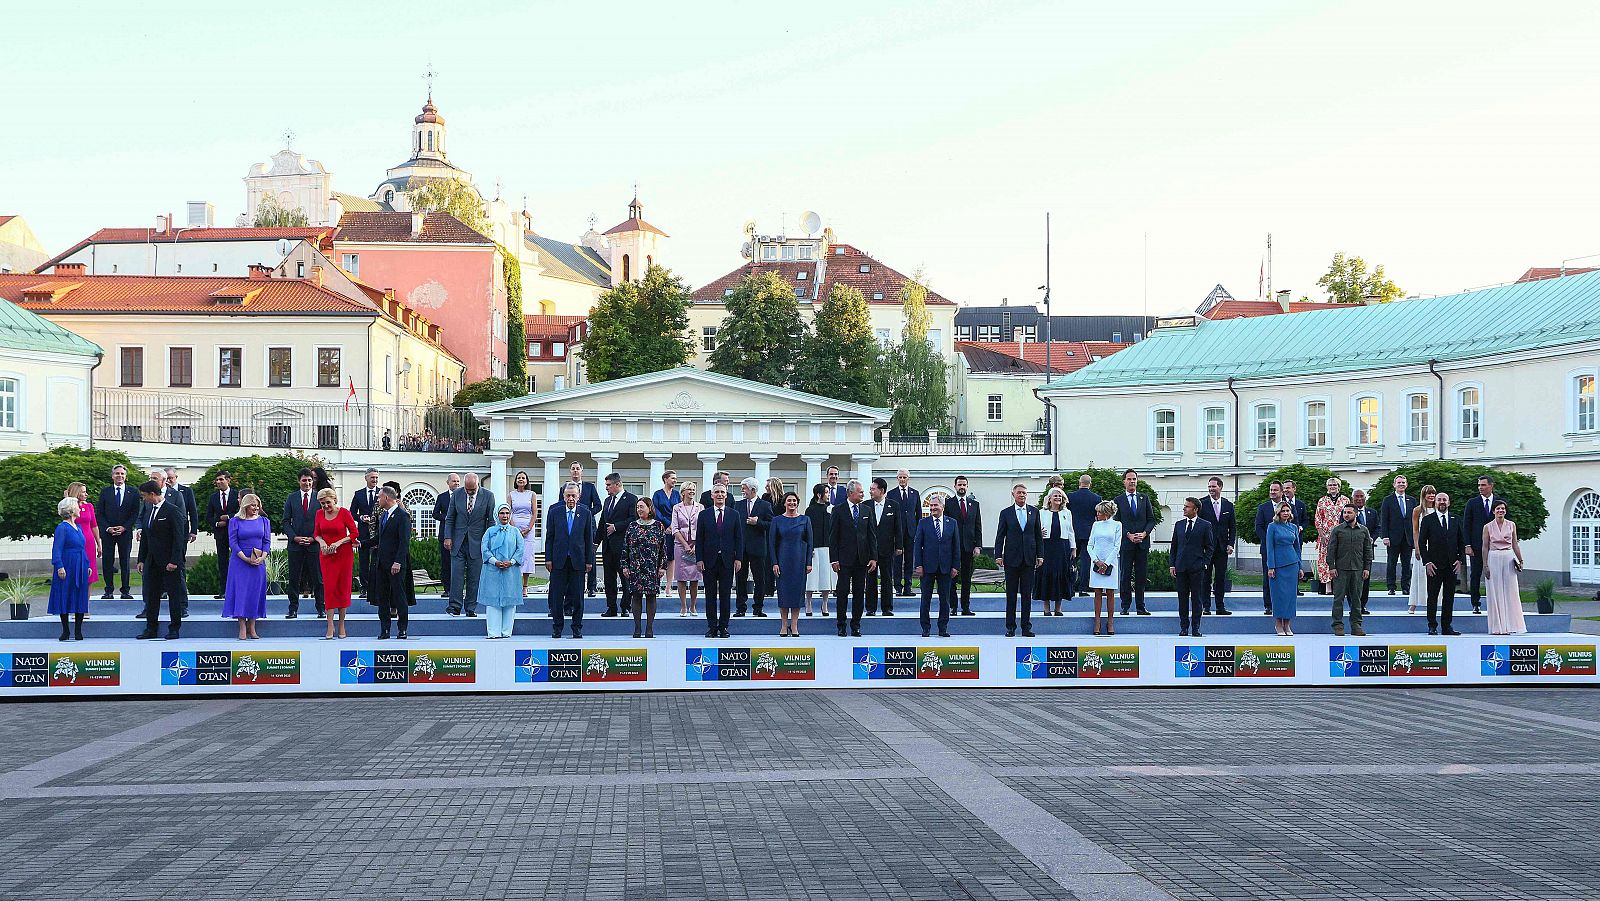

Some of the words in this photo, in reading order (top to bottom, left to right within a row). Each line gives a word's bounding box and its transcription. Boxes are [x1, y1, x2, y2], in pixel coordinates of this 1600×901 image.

[721, 652, 748, 660] NATO
[887, 651, 914, 660] NATO
[1049, 650, 1075, 659] NATO
[1207, 650, 1232, 658] NATO
[1361, 650, 1386, 658] NATO
[1512, 649, 1536, 657] NATO
[15, 657, 46, 666] NATO
[199, 656, 228, 664] NATO
[377, 654, 405, 663] NATO
[551, 653, 578, 662] NATO
[720, 668, 748, 676] OTAN
[886, 667, 914, 675] OTAN
[1049, 667, 1075, 675] OTAN
[1361, 665, 1386, 673] OTAN
[1512, 664, 1536, 672] OTAN
[198, 672, 228, 681] OTAN
[376, 671, 405, 680] OTAN
[550, 670, 578, 678] OTAN
[15, 674, 45, 683] OTAN
